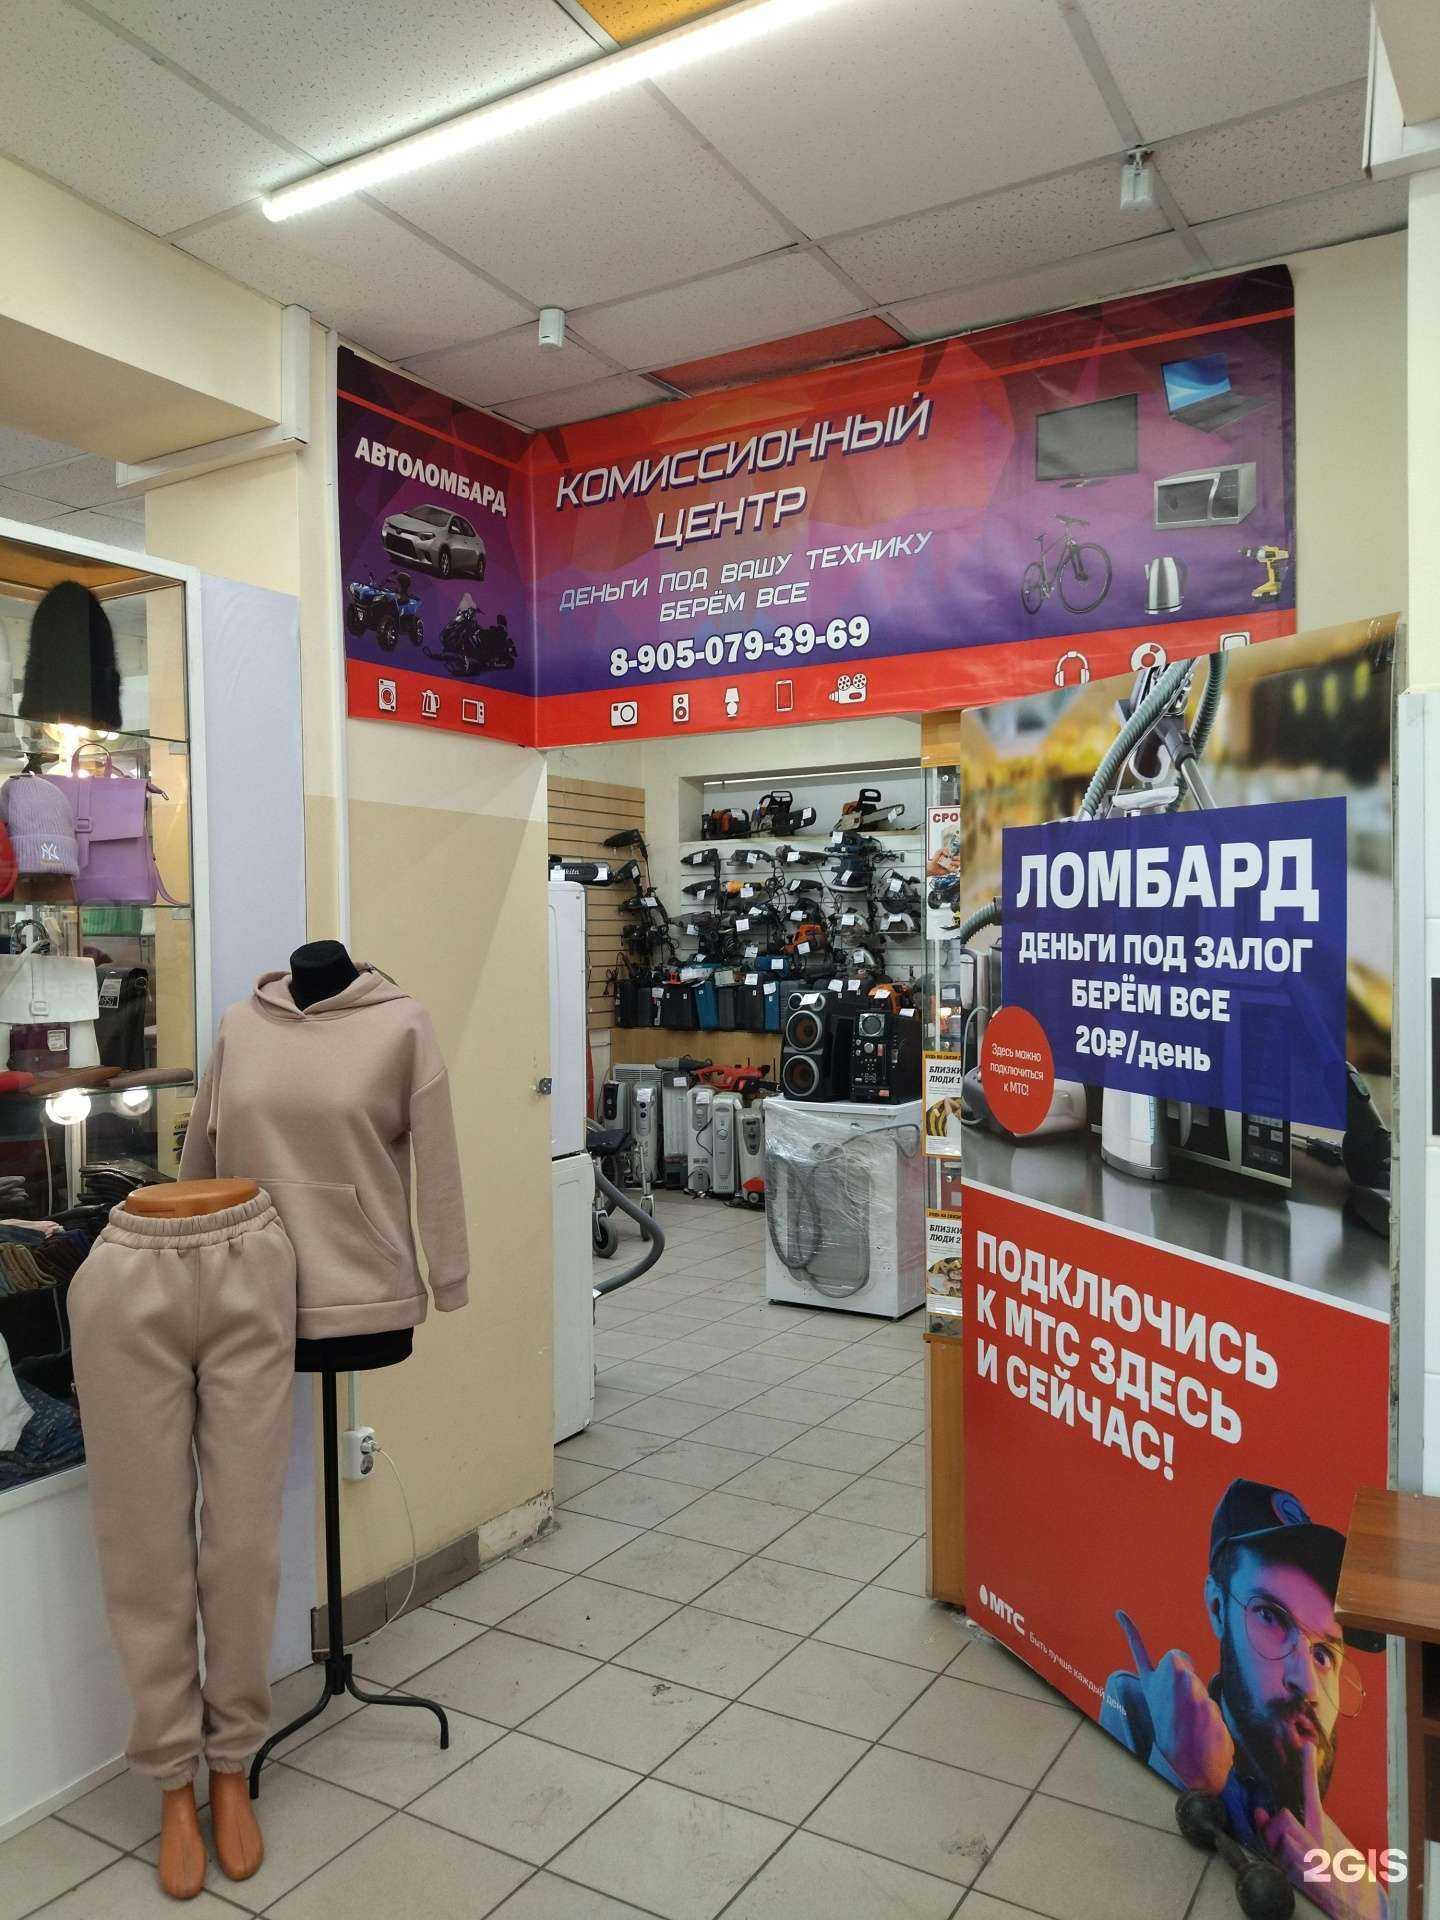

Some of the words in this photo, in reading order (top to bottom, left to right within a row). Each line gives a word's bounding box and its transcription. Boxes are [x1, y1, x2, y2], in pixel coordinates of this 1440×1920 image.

[555, 391, 934, 511] КОМИССИОННЫЙ
[354, 436, 507, 518] АВТОЛОМБАРД
[653, 485, 807, 551] ЦЕНТР
[559, 577, 649, 612] ДЕНЬГИ
[658, 567, 708, 594] ПОД
[720, 553, 793, 584] ВАШУ
[806, 531, 934, 570] ТЕХНИКУ
[659, 590, 746, 623] БЕРЁМ
[756, 581, 810, 609] ВСЕ
[609, 615, 871, 678] 8-905-079-39-69
[40, 842, 60, 860] NY
[1016, 838, 1320, 922] ЛОМБАРД
[1018, 931, 1116, 964] ДЕНЬГИ
[1123, 934, 1187, 973] ПОД
[1194, 936, 1313, 973] ЗАЛОГ
[1071, 973, 1162, 1015] БЕРЁМ
[1170, 986, 1231, 1022] ВСЕ
[990, 1062, 1044, 1081] подключиться
[991, 1042, 1014, 1058] Здесь
[1015, 1049, 1042, 1063] можно
[1075, 1025, 1211, 1072] 20₽/день
[929, 1075, 955, 1085] ЛЮДИ
[1003, 1082, 1009, 1093] к
[1009, 1081, 1029, 1097] МТС!
[929, 1233, 955, 1244] ЛЮДИ
[976, 1229, 1279, 1390] ПОДКЛЮЧИСЬ
[976, 1283, 998, 1330] К
[1005, 1296, 1080, 1368] МТС
[1090, 1336, 1243, 1445] ЗДЕСЬ
[976, 1337, 998, 1385] И
[1006, 1355, 1175, 1481] СЕЙЧАС!
[989, 1591, 1026, 1636] МТС
[1029, 1631, 1049, 1654] Быть
[1048, 1648, 1073, 1674] лучше
[1073, 1667, 1106, 1702] каждый
[1106, 1695, 1128, 1717] день
